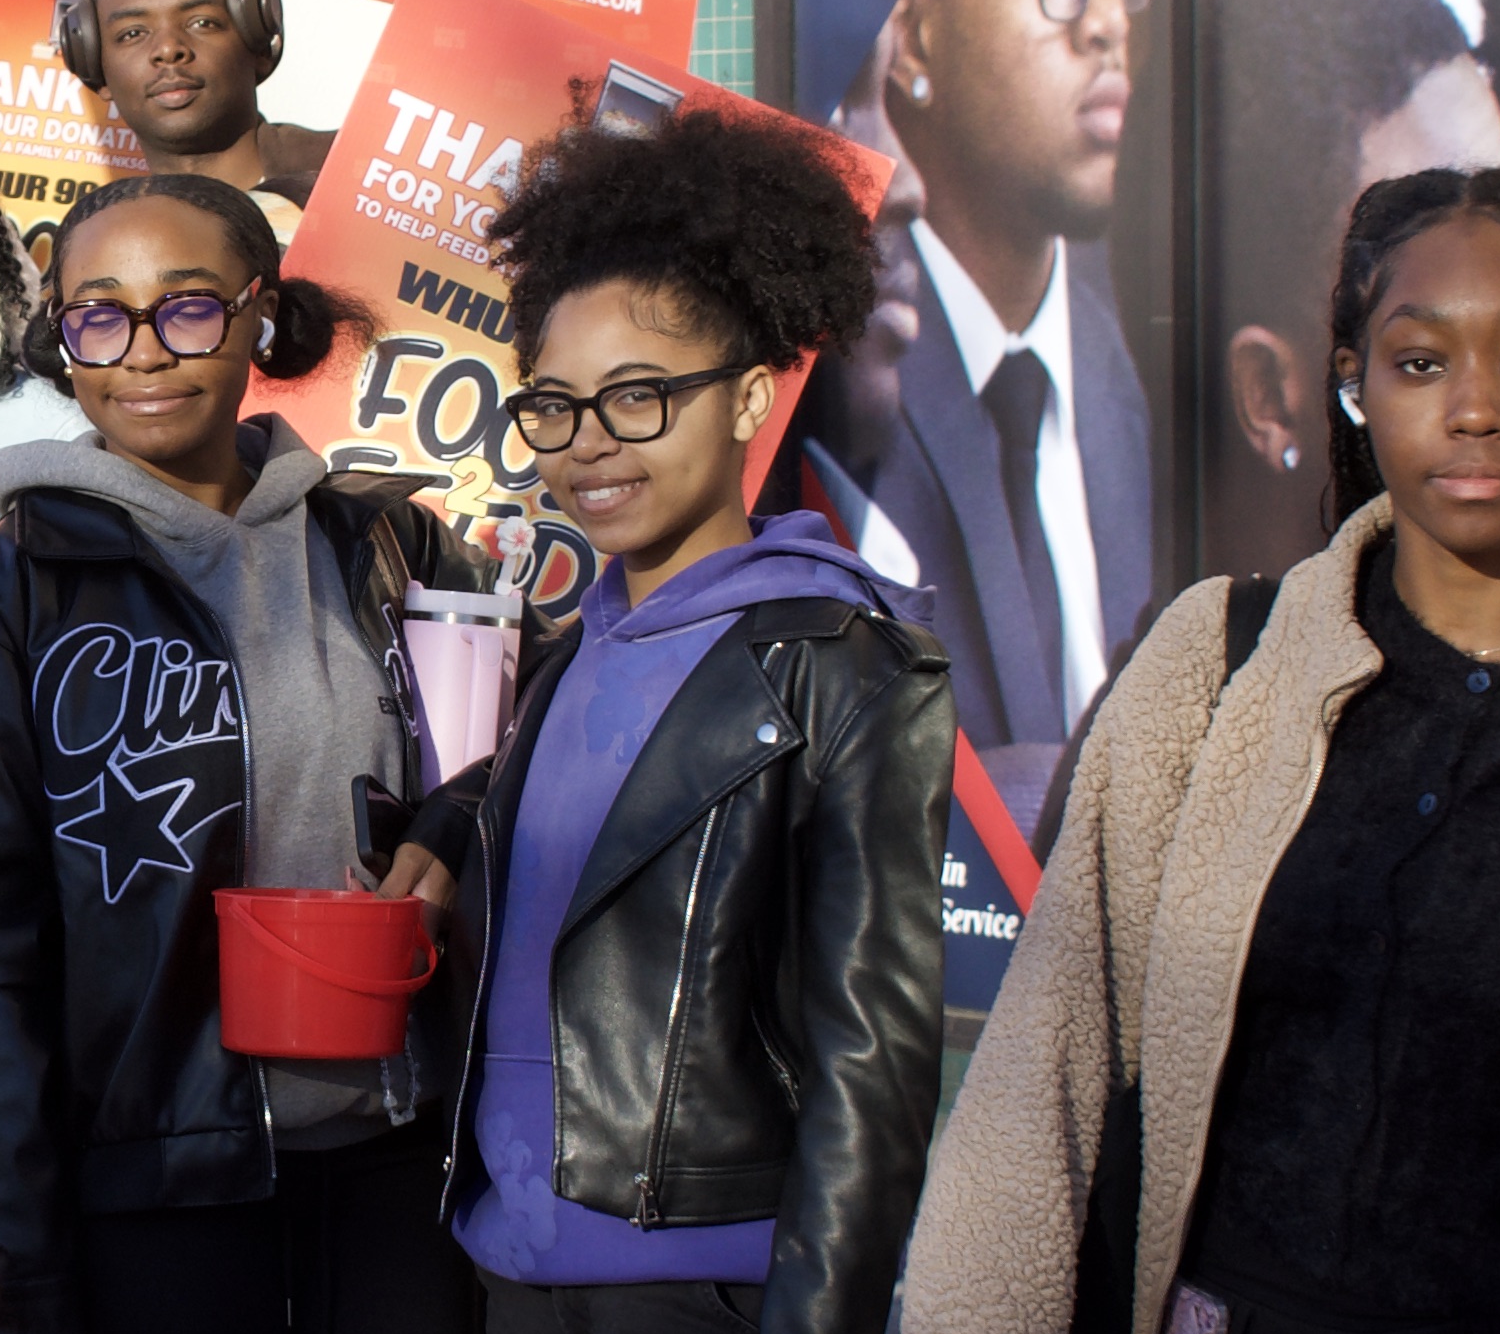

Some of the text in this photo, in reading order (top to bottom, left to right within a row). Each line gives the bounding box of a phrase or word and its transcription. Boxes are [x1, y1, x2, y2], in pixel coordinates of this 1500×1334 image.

[40, 116, 140, 153] DONATI
[386, 88, 525, 205] THA
[353, 193, 491, 265] TO HELP FEED
[361, 156, 498, 240] FOR YO
[396, 260, 518, 344] WHU
[940, 851, 968, 888] in
[941, 897, 1020, 941] Service
